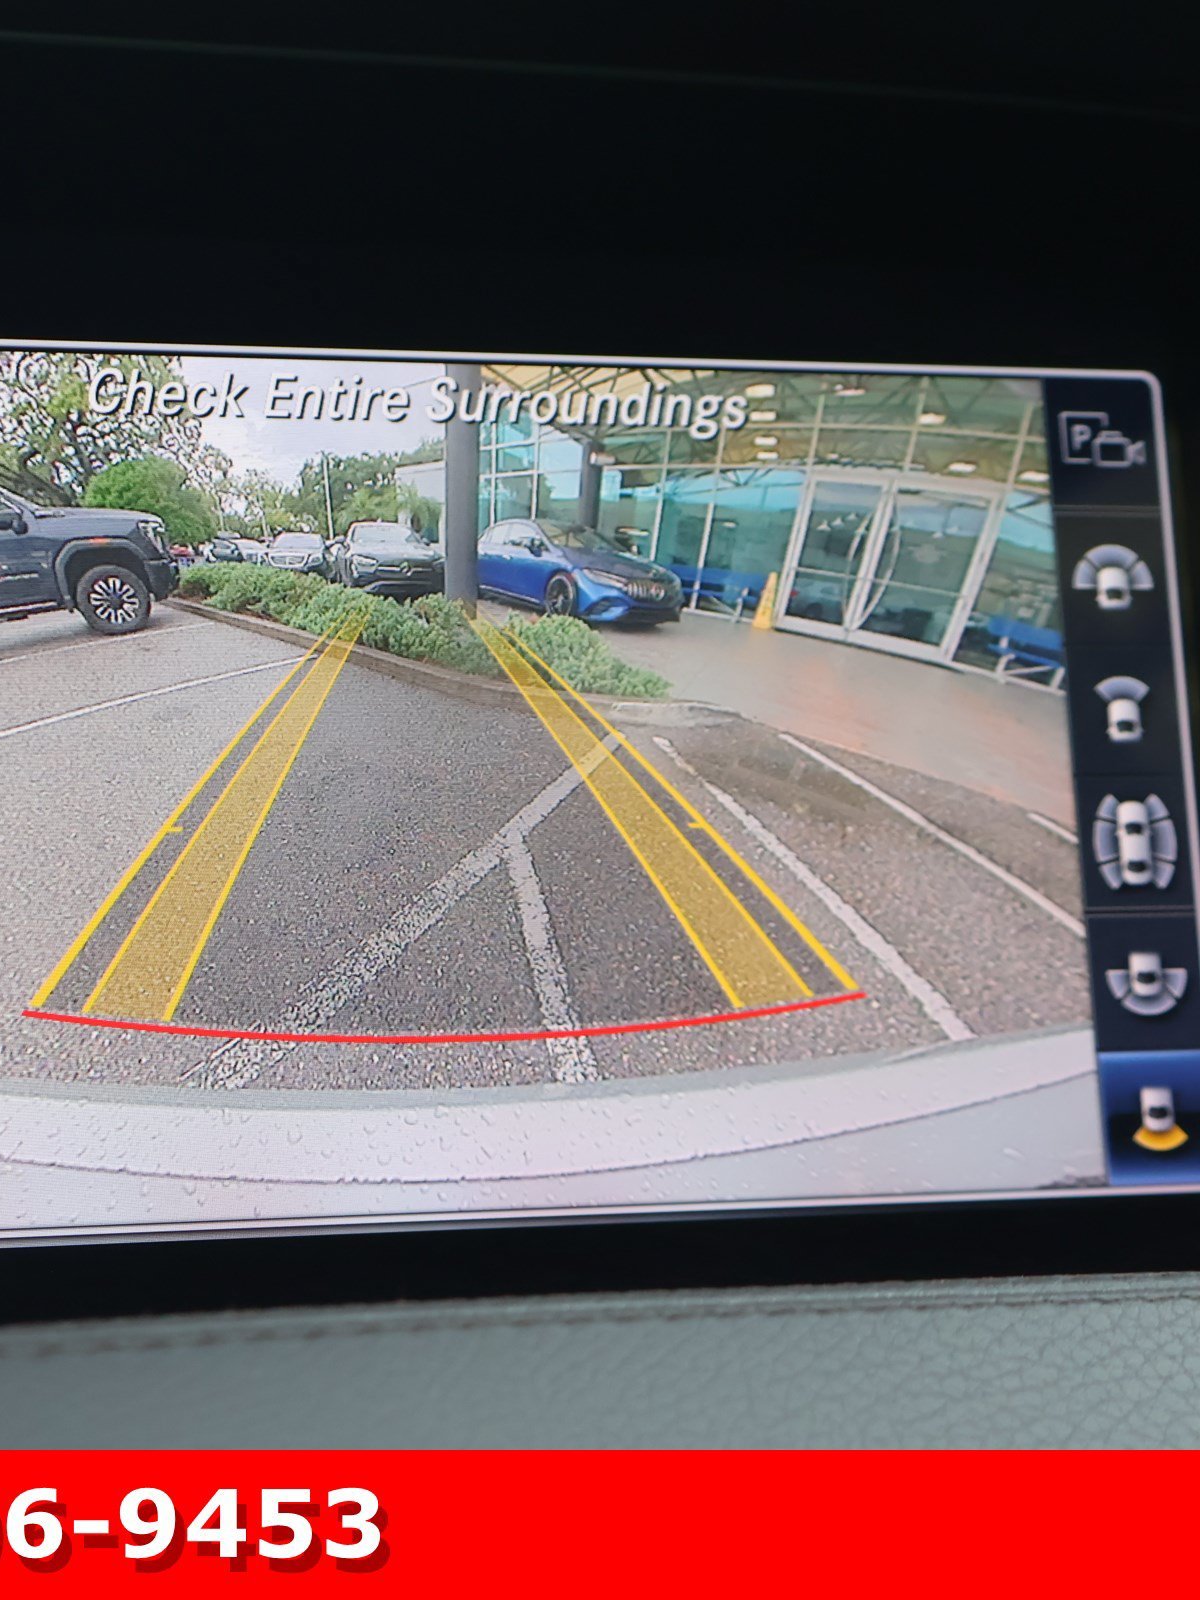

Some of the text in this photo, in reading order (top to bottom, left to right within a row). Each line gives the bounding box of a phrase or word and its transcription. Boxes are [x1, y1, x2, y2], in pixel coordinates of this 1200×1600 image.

[87, 367, 748, 439] Check Entire Surroundings
[1071, 424, 1091, 450] P
